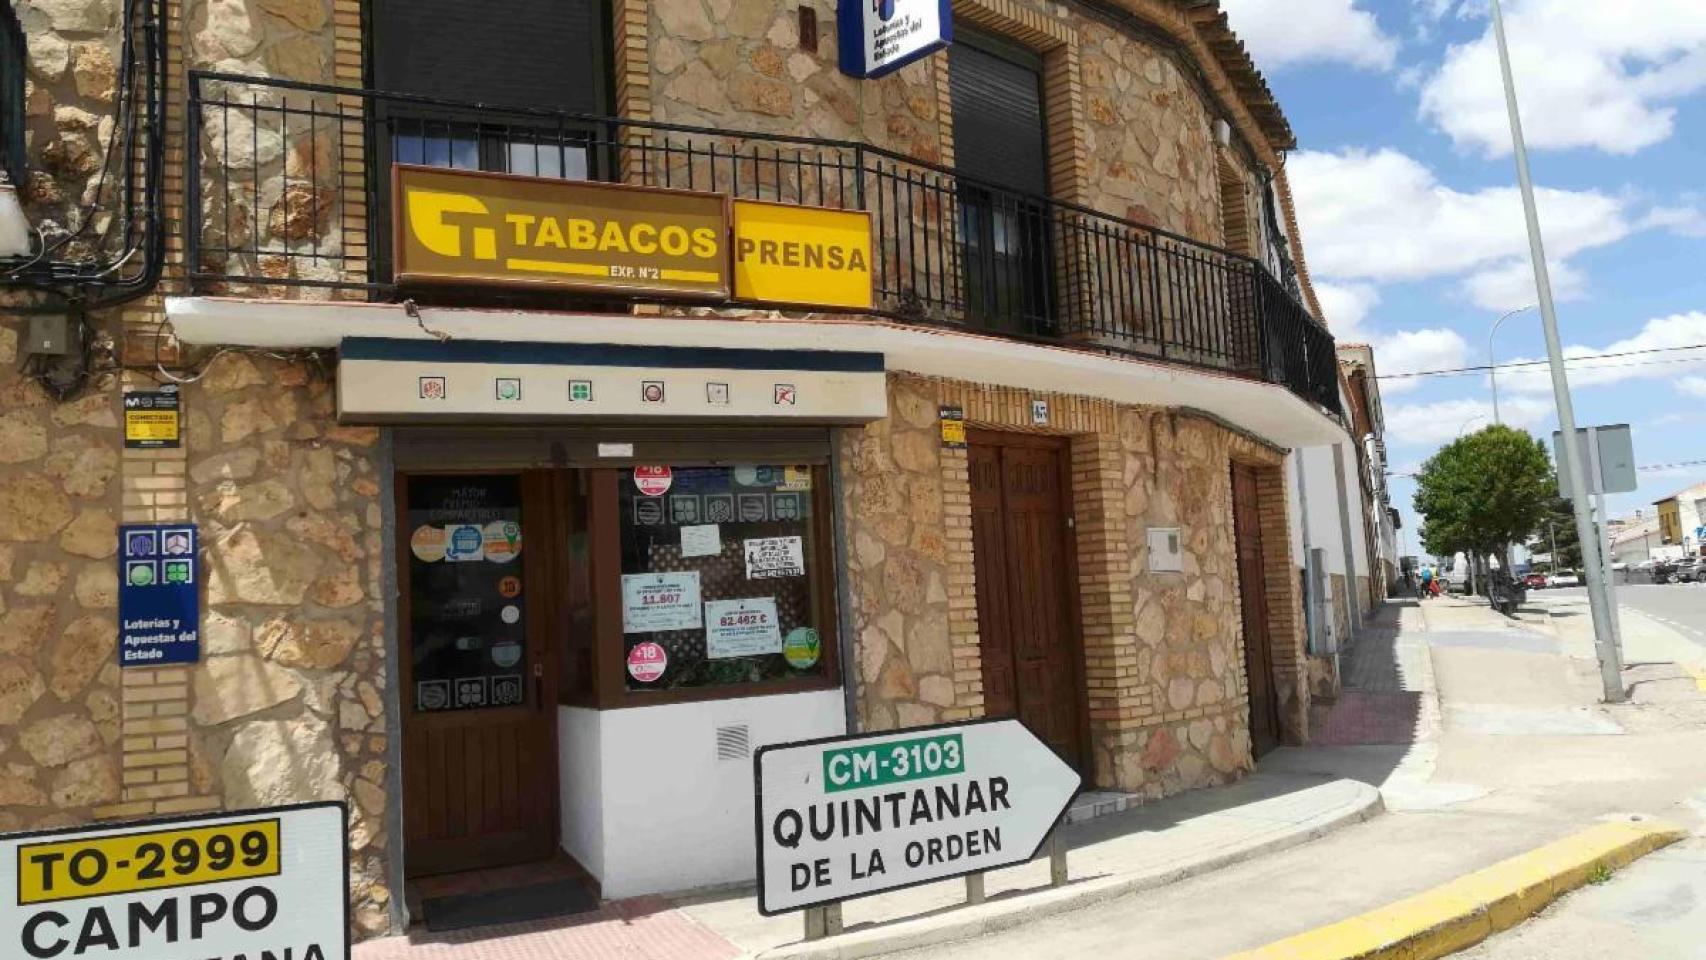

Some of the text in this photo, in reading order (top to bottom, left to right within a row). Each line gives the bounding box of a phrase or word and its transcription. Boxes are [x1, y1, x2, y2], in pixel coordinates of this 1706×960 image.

[505, 213, 718, 259] TABACOS
[737, 237, 867, 273] PRENSA
[610, 265, 635, 279] EXP.
[124, 618, 180, 630] Loterías y
[124, 631, 197, 647] Apuestas del
[124, 648, 163, 661] Estado
[827, 739, 962, 785] CM-3103
[772, 776, 1012, 849] QUINTANAR
[30, 830, 269, 891] TO-2999
[791, 826, 1002, 892] DE LA ORDEN
[20, 885, 278, 959] CAMPO
